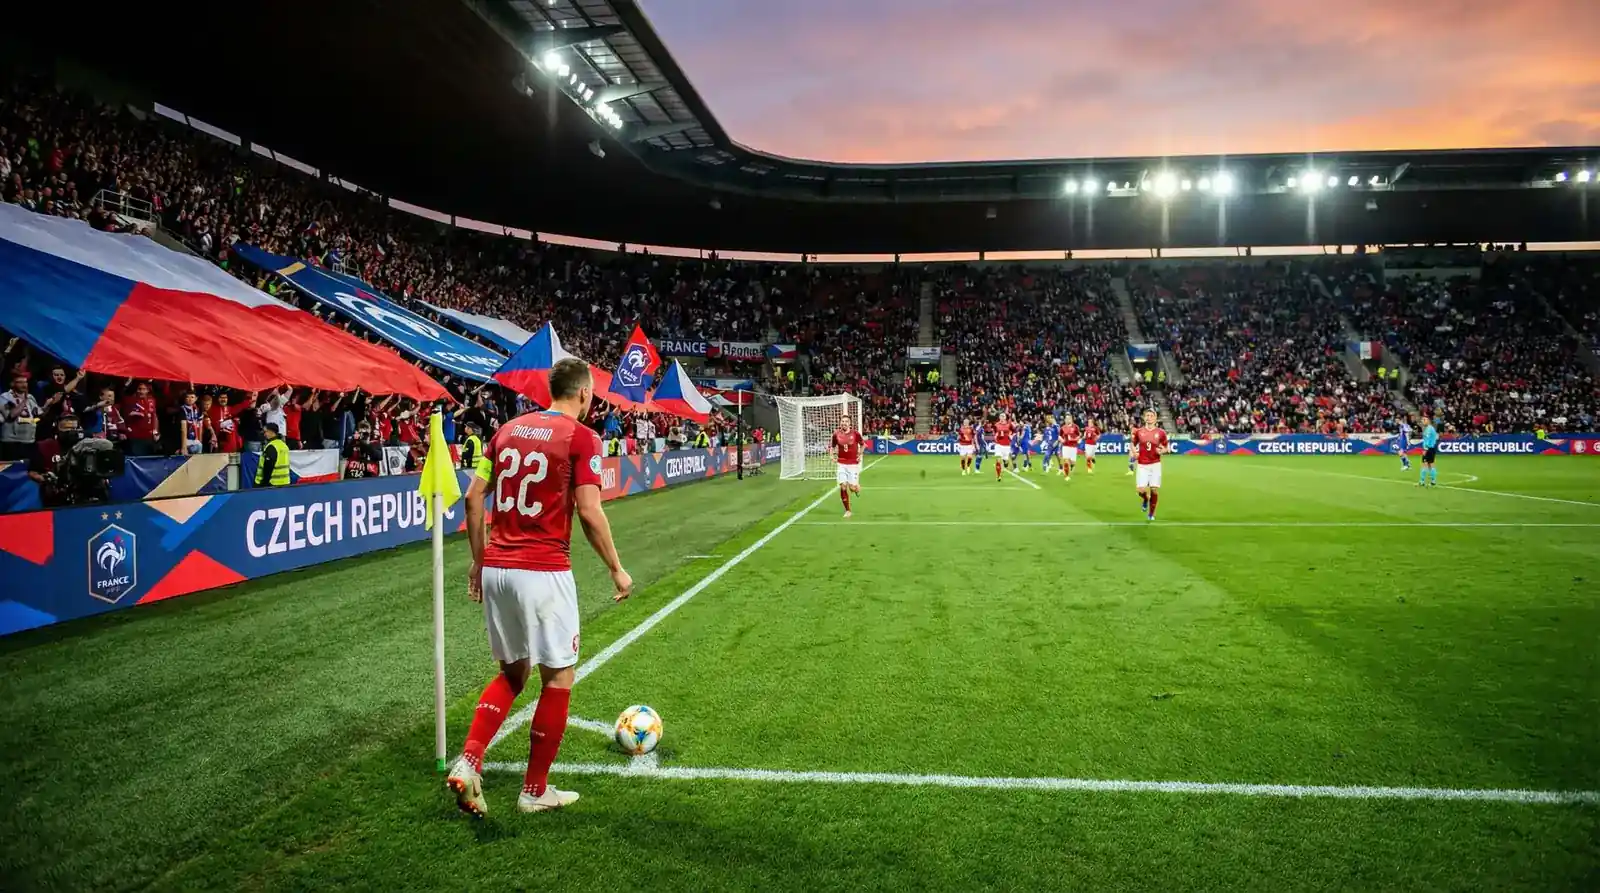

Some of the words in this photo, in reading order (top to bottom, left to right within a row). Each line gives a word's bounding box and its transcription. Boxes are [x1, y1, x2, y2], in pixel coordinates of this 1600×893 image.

[660, 340, 707, 353] FRANCE
[917, 443, 951, 452] CZECH
[1095, 442, 1121, 453] ZECH
[1145, 441, 1152, 451] 9
[1258, 442, 1295, 453] CZECH
[1297, 441, 1353, 453] REPUBLIC
[1438, 442, 1476, 453] CZECH
[1478, 442, 1534, 453] REPUBLIC
[496, 447, 549, 518] 22
[246, 500, 343, 557] CZECH
[351, 489, 454, 538] REPUB
[97, 575, 129, 588] FRANCE
